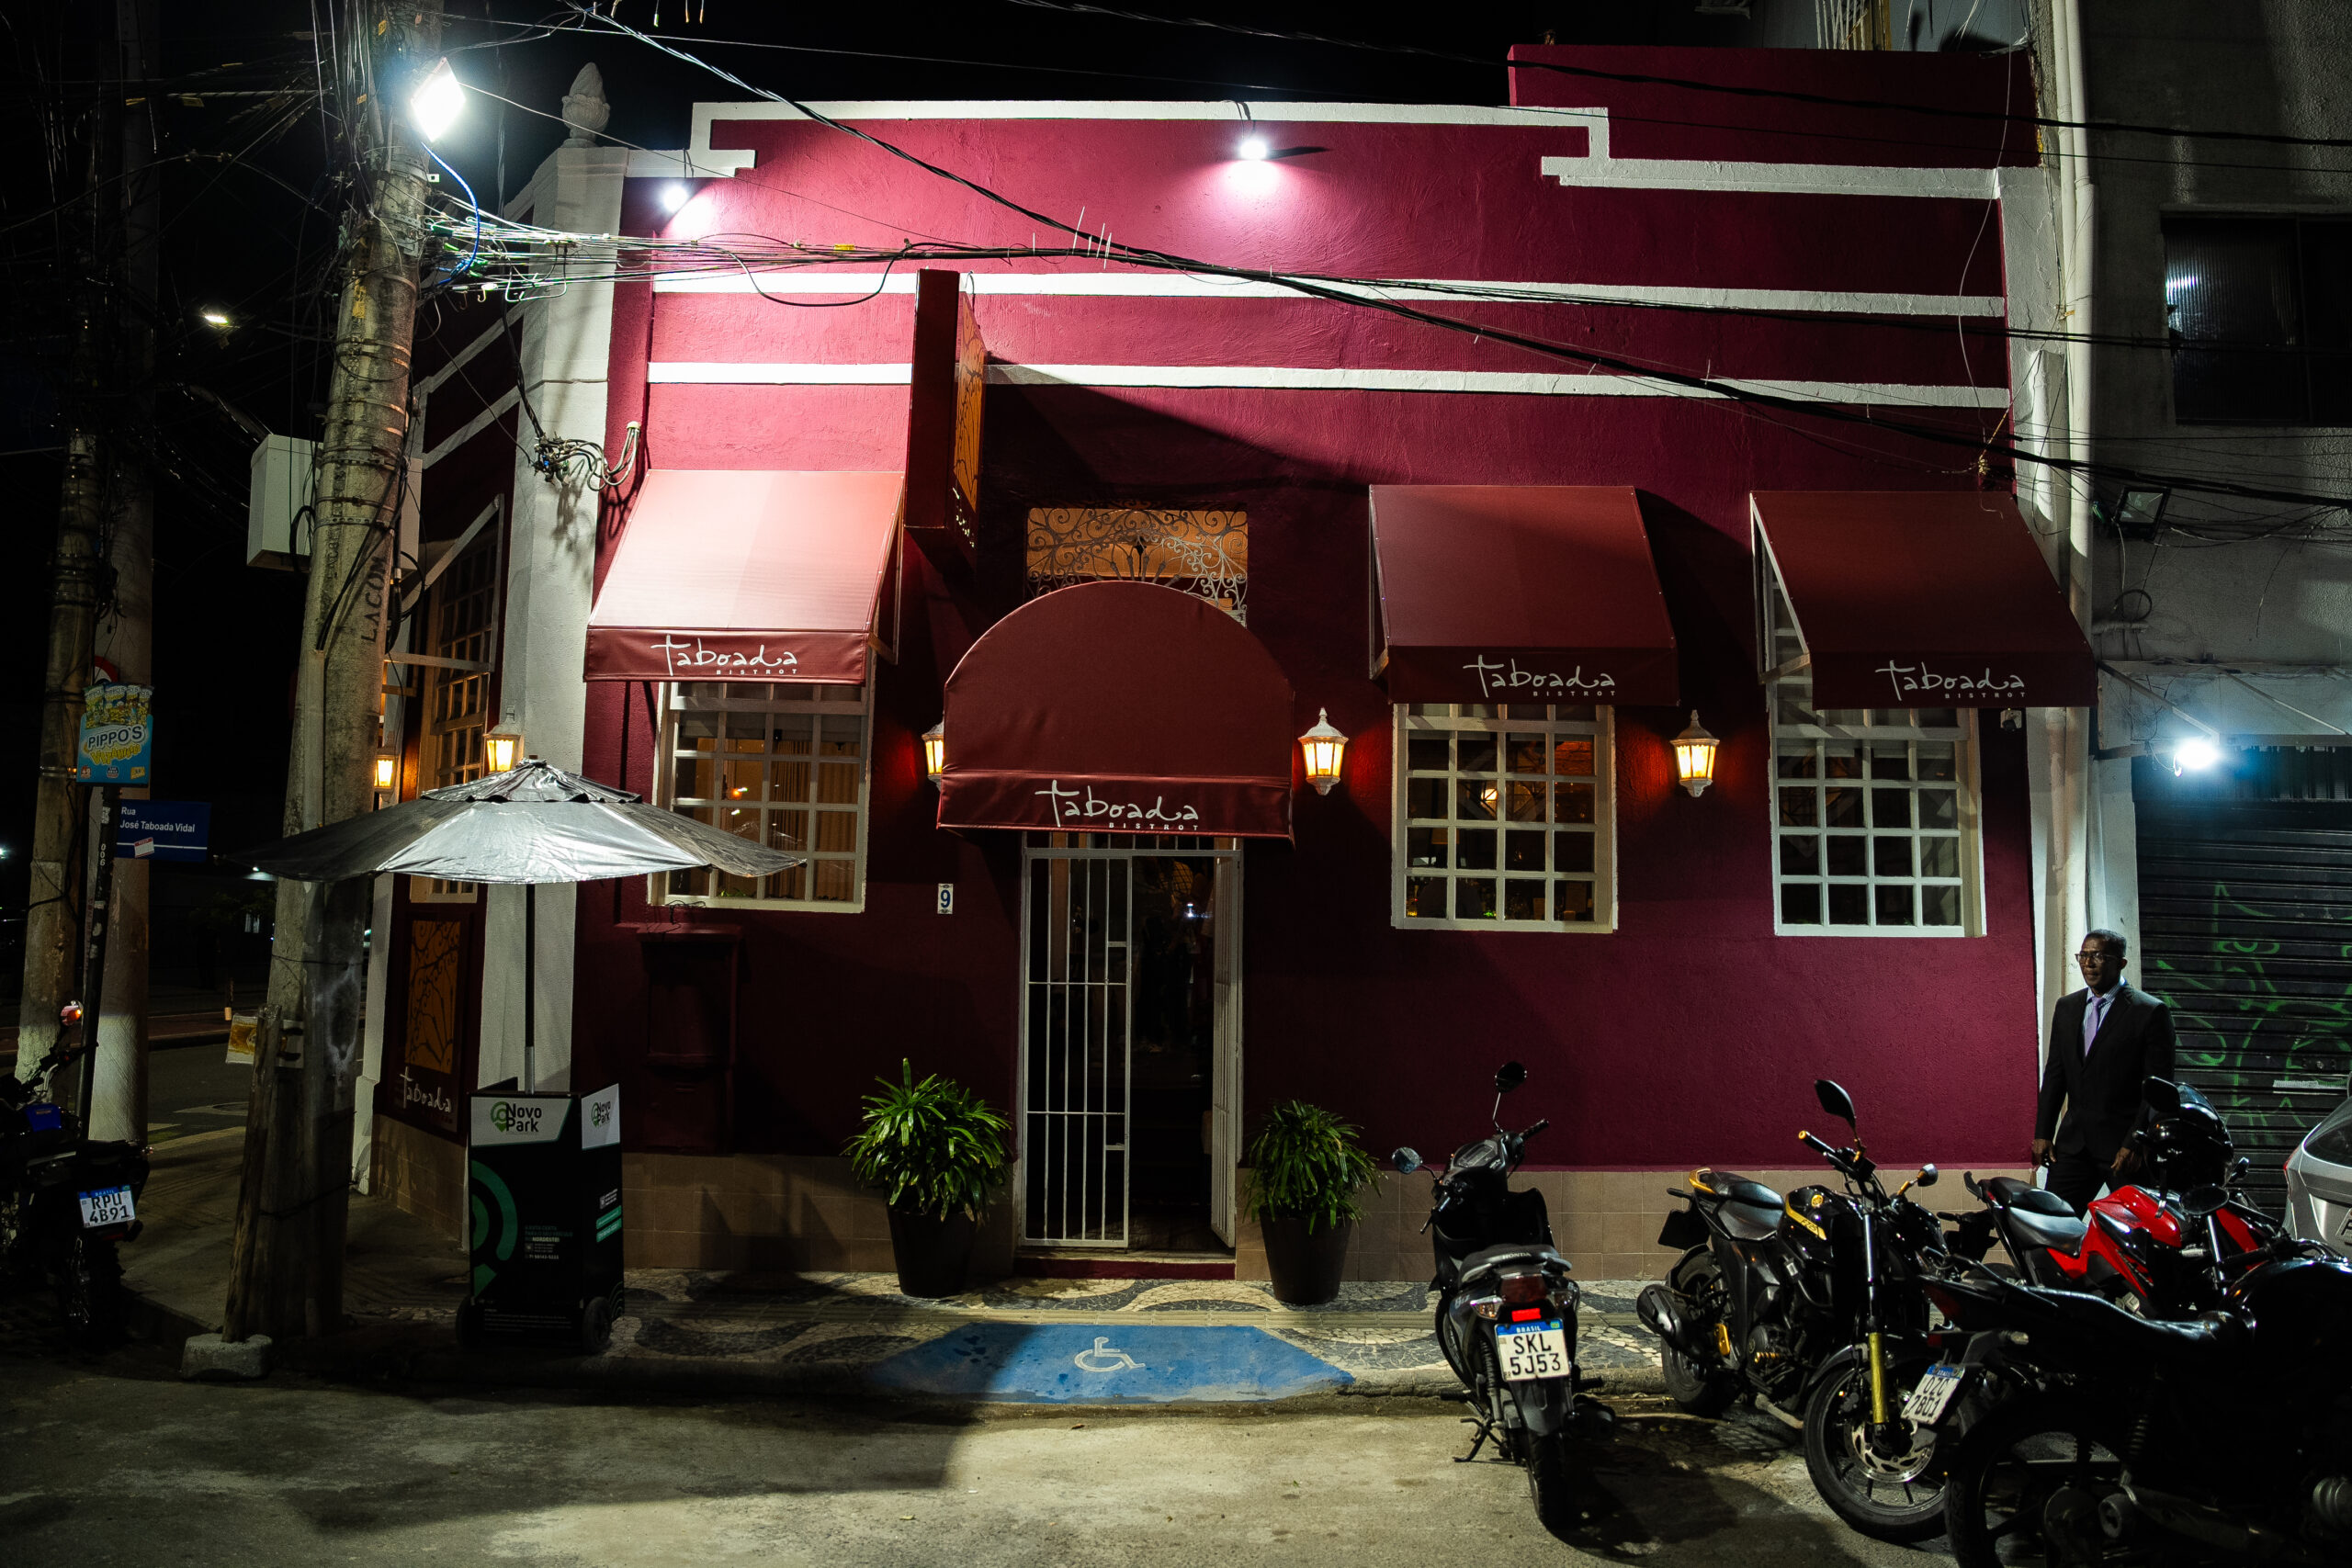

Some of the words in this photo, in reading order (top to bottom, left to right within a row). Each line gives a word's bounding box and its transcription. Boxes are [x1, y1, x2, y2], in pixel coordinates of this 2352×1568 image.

[650, 634, 797, 676] Taboada
[1463, 654, 1615, 697] Taboada
[1874, 660, 2025, 701] Taboada
[120, 807, 136, 816] Rua
[1035, 779, 1199, 828] Taboada
[119, 819, 140, 829] José
[141, 820, 174, 831] Taboada
[175, 822, 196, 832] Vidal
[1109, 822, 1198, 831] BISTROT
[940, 889, 951, 908] 9
[399, 1066, 452, 1113] Taboada
[506, 1103, 542, 1118] Novo
[597, 1100, 611, 1112] Novo
[506, 1117, 539, 1133] Park
[597, 1111, 610, 1123] Park
[92, 1193, 122, 1210] RPU
[90, 1205, 130, 1224] 4B91
[1513, 1333, 1552, 1354] SKL
[1510, 1353, 1561, 1375] 5J53
